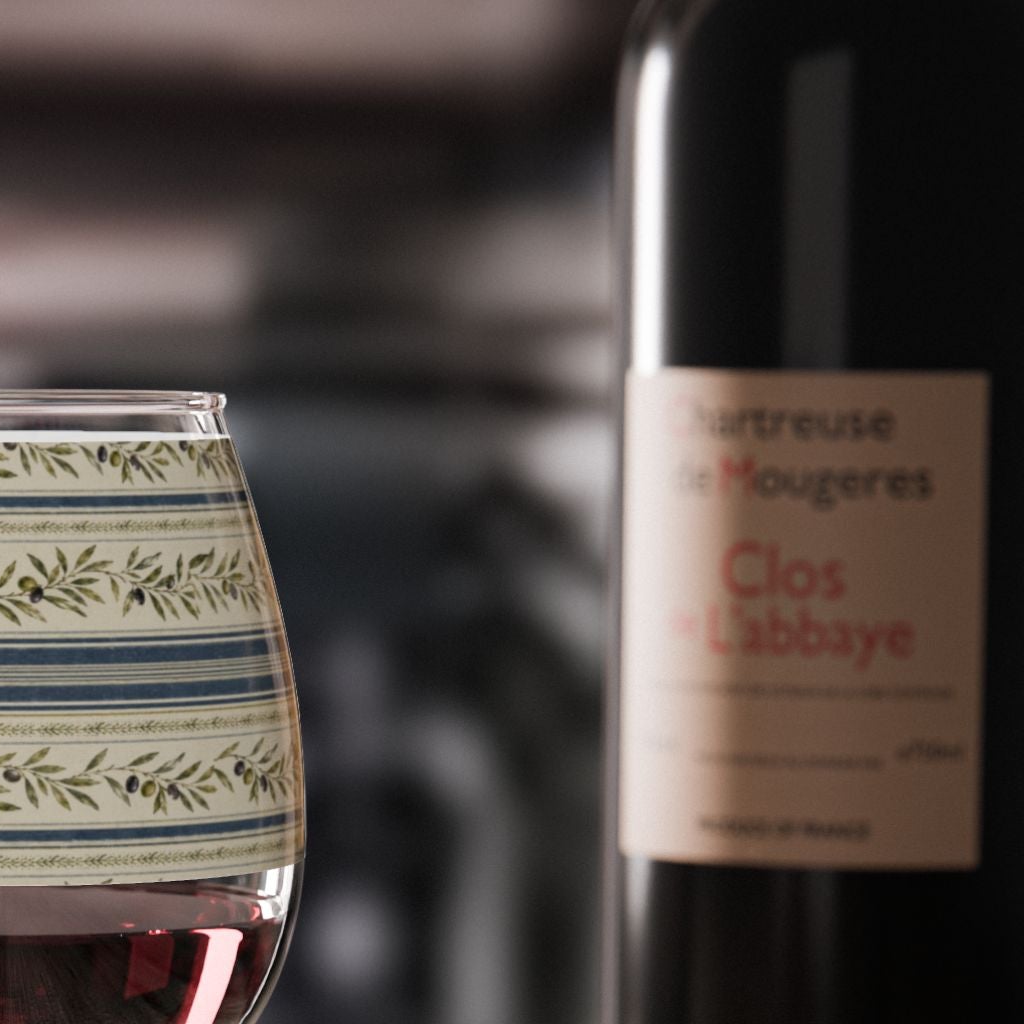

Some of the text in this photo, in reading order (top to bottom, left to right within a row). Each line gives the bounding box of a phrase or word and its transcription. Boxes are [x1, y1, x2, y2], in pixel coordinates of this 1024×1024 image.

[719, 456, 935, 511] Mougeres
[721, 540, 846, 599] Clos
[707, 604, 916, 670] L'abbaye
